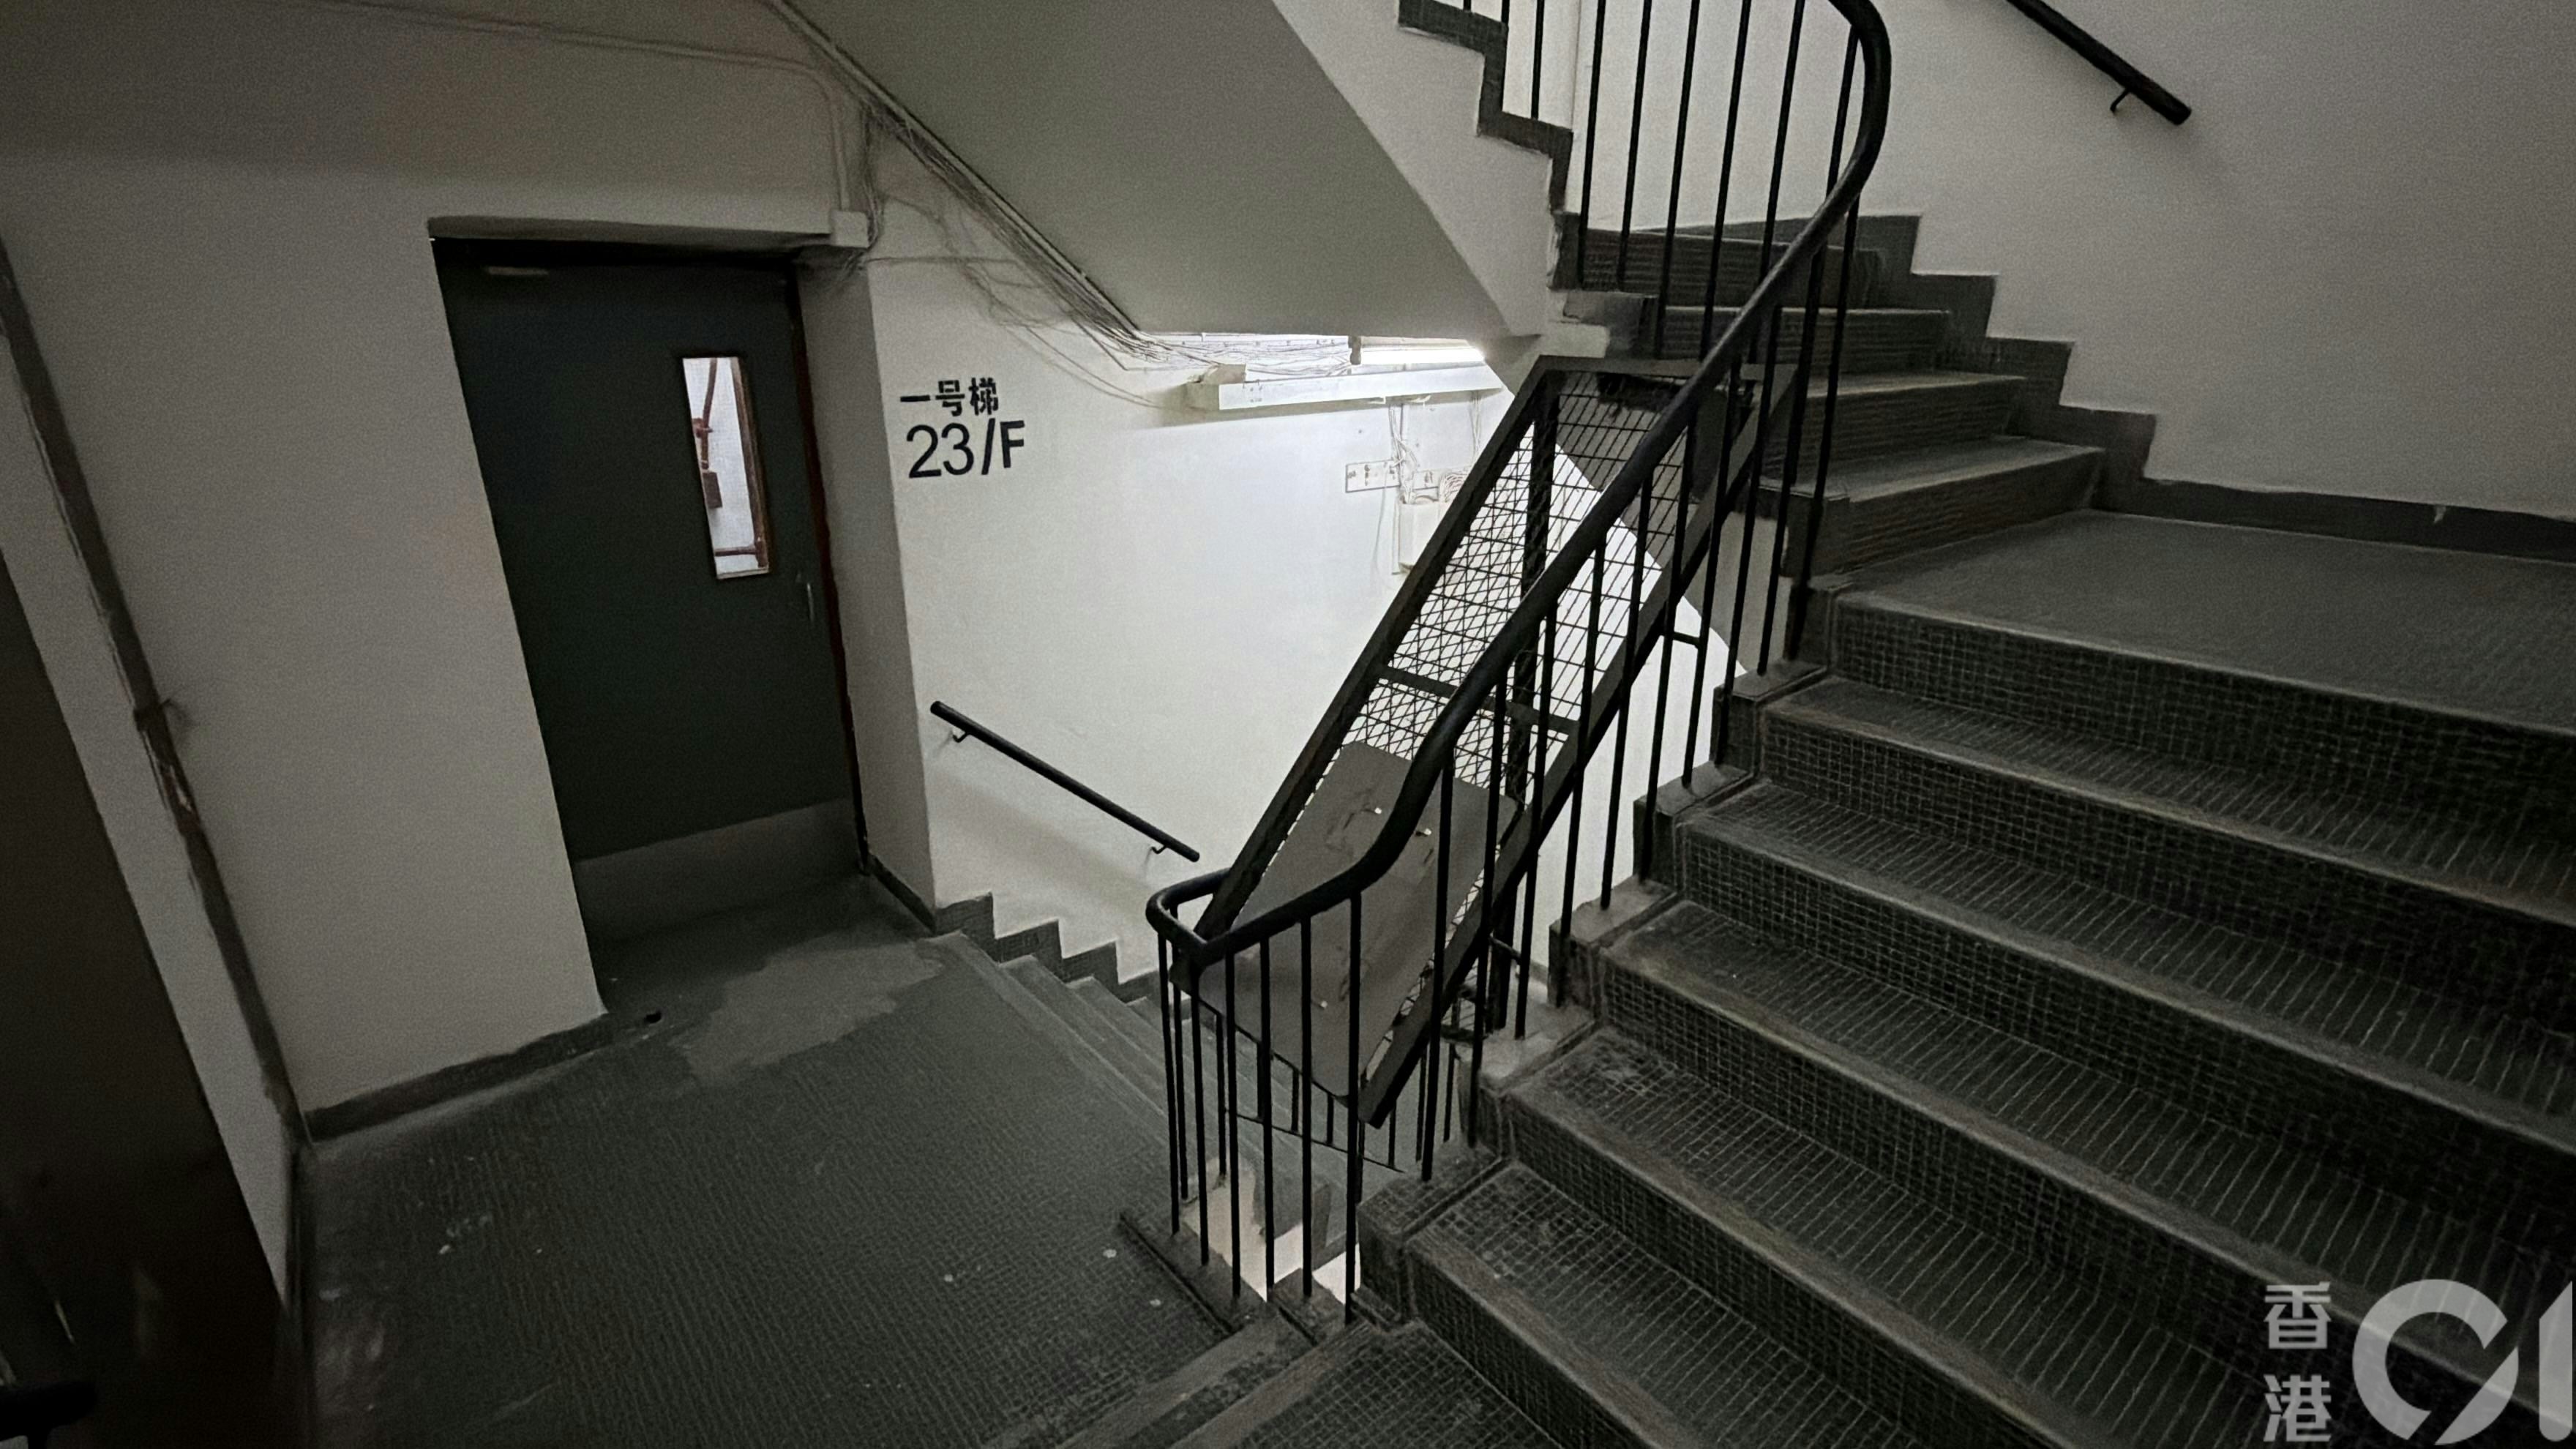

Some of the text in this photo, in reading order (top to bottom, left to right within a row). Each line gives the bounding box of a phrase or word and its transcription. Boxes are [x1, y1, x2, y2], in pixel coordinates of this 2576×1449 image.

[900, 377, 999, 416] 一号梯
[907, 418, 1025, 479] 23/F
